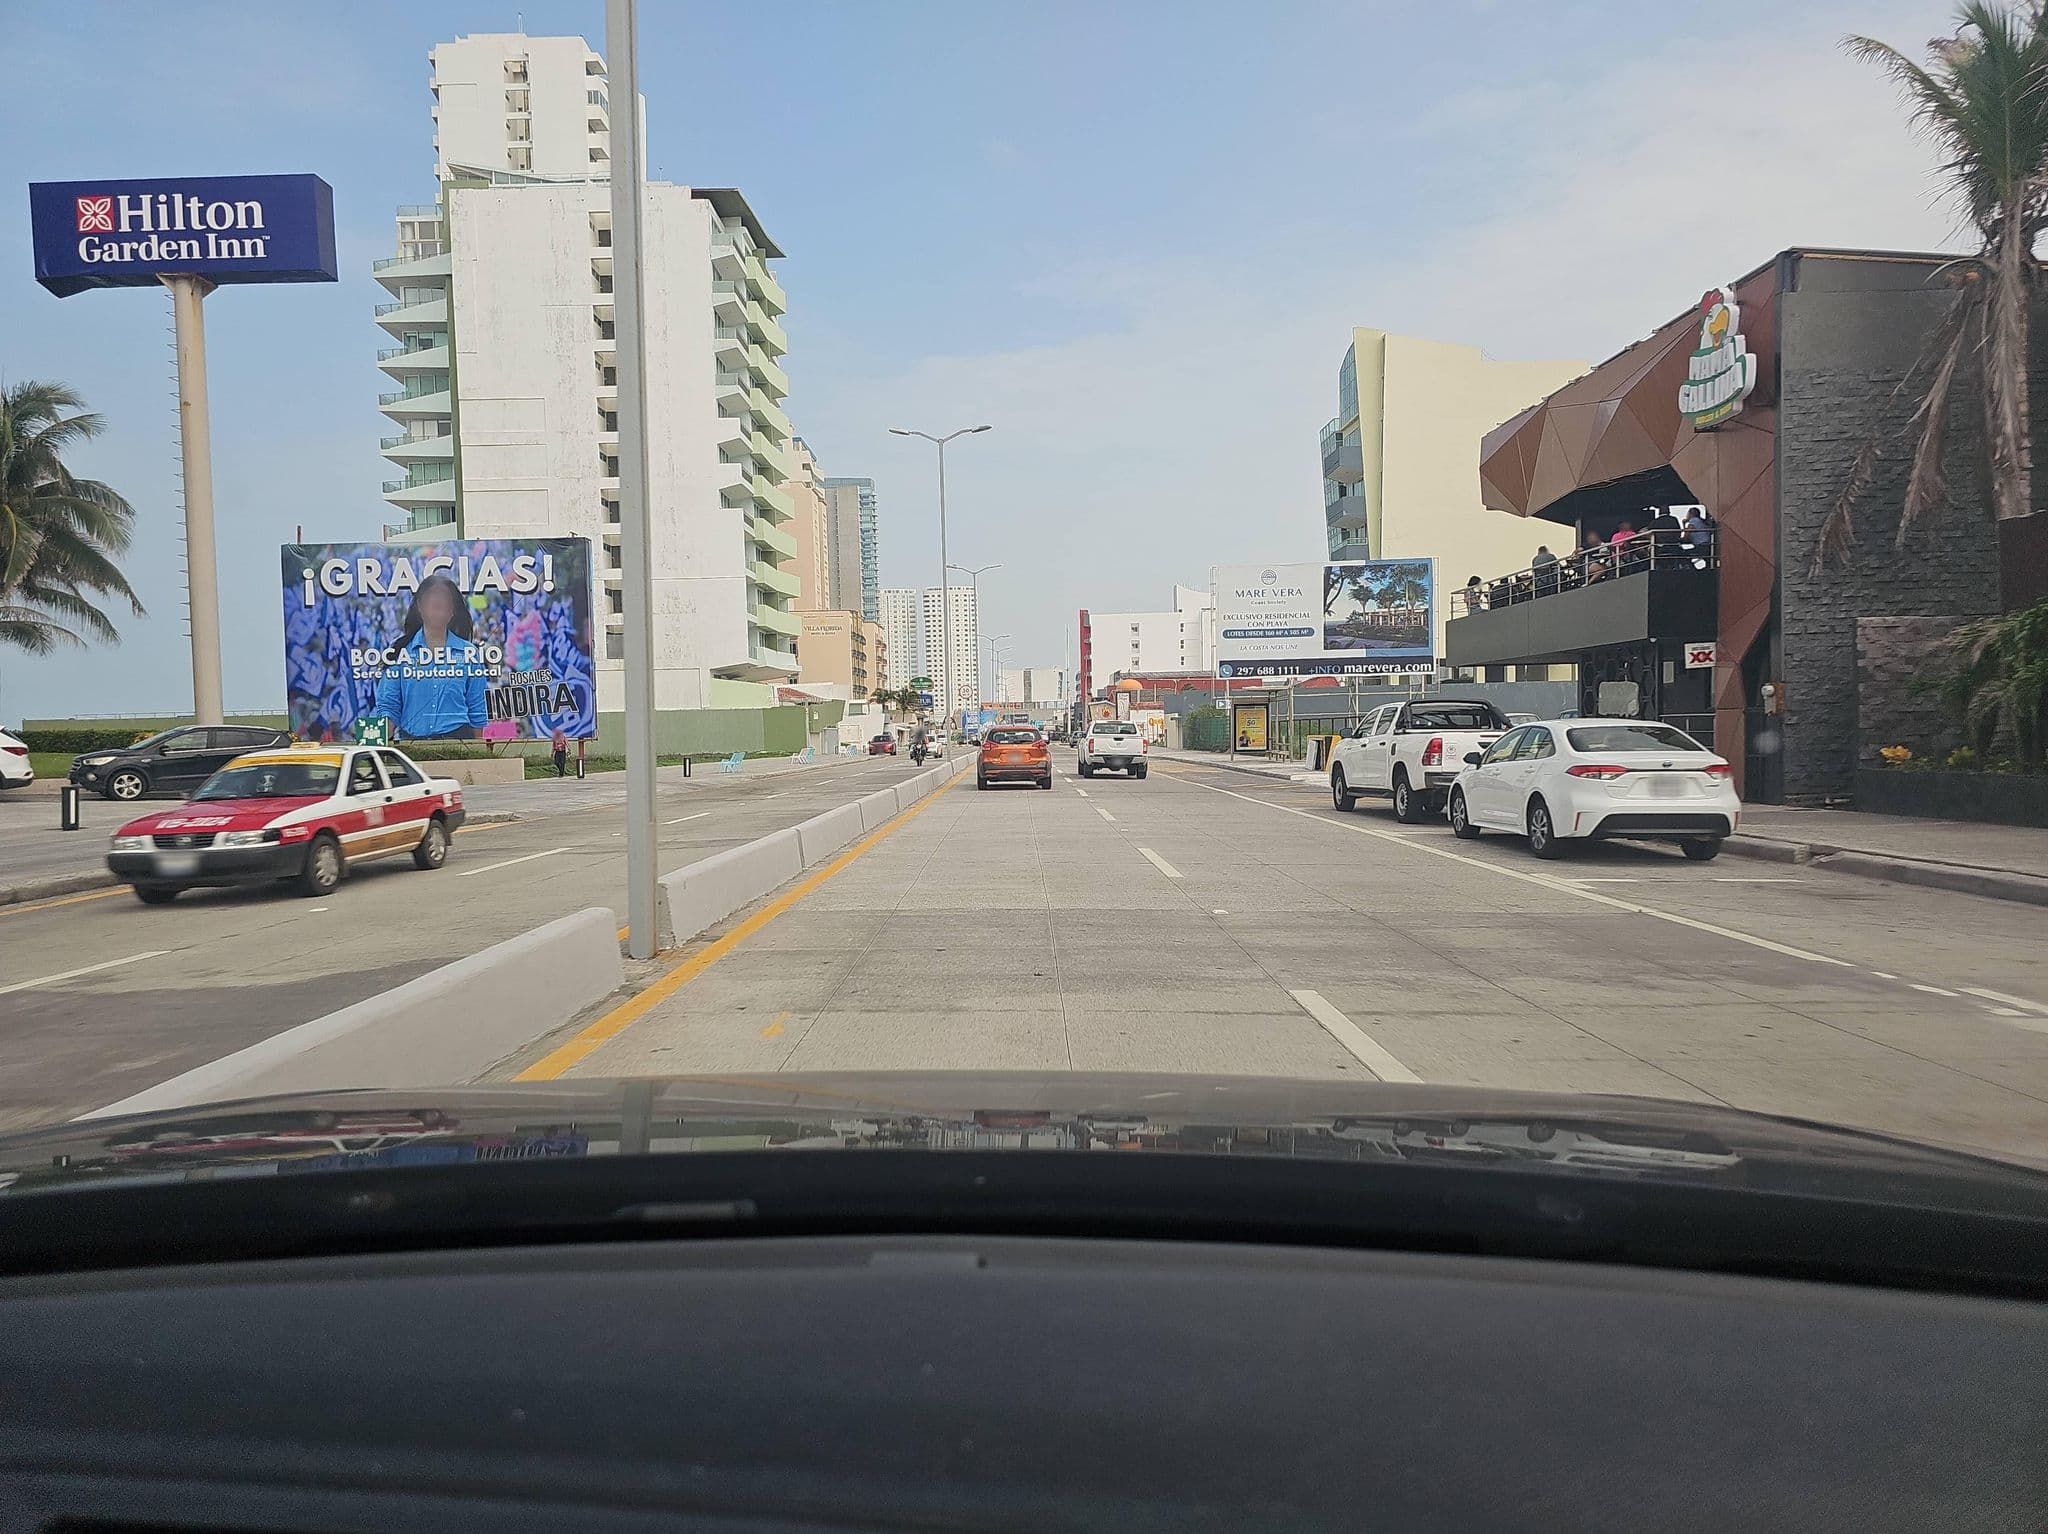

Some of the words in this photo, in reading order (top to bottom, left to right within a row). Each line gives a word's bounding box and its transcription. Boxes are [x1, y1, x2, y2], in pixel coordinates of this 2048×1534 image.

[118, 193, 265, 232] Hilton
[77, 233, 202, 263] Garden
[302, 554, 556, 607] ¡GRACIAS!
[1234, 589, 1267, 599] MARE
[1272, 588, 1304, 598] VERA
[1223, 613, 1263, 621] EXCLUSIVO
[1264, 612, 1311, 620] RESIDENCIAL
[1266, 620, 1289, 628] PLAYA
[350, 647, 413, 666] BOCA
[419, 647, 457, 666] DEL
[464, 641, 503, 665] RÍO
[353, 666, 382, 679] Seré
[386, 668, 399, 679] tu
[403, 666, 464, 680] Diputada
[467, 665, 502, 678] Local
[509, 668, 553, 685] ROSALES
[1236, 666, 1254, 676] 297
[1256, 665, 1275, 675] 688
[1277, 665, 1299, 675] 1111
[1308, 664, 1341, 675] +INFO
[1343, 662, 1432, 674] marevera.com
[484, 681, 580, 721] INDIRA
